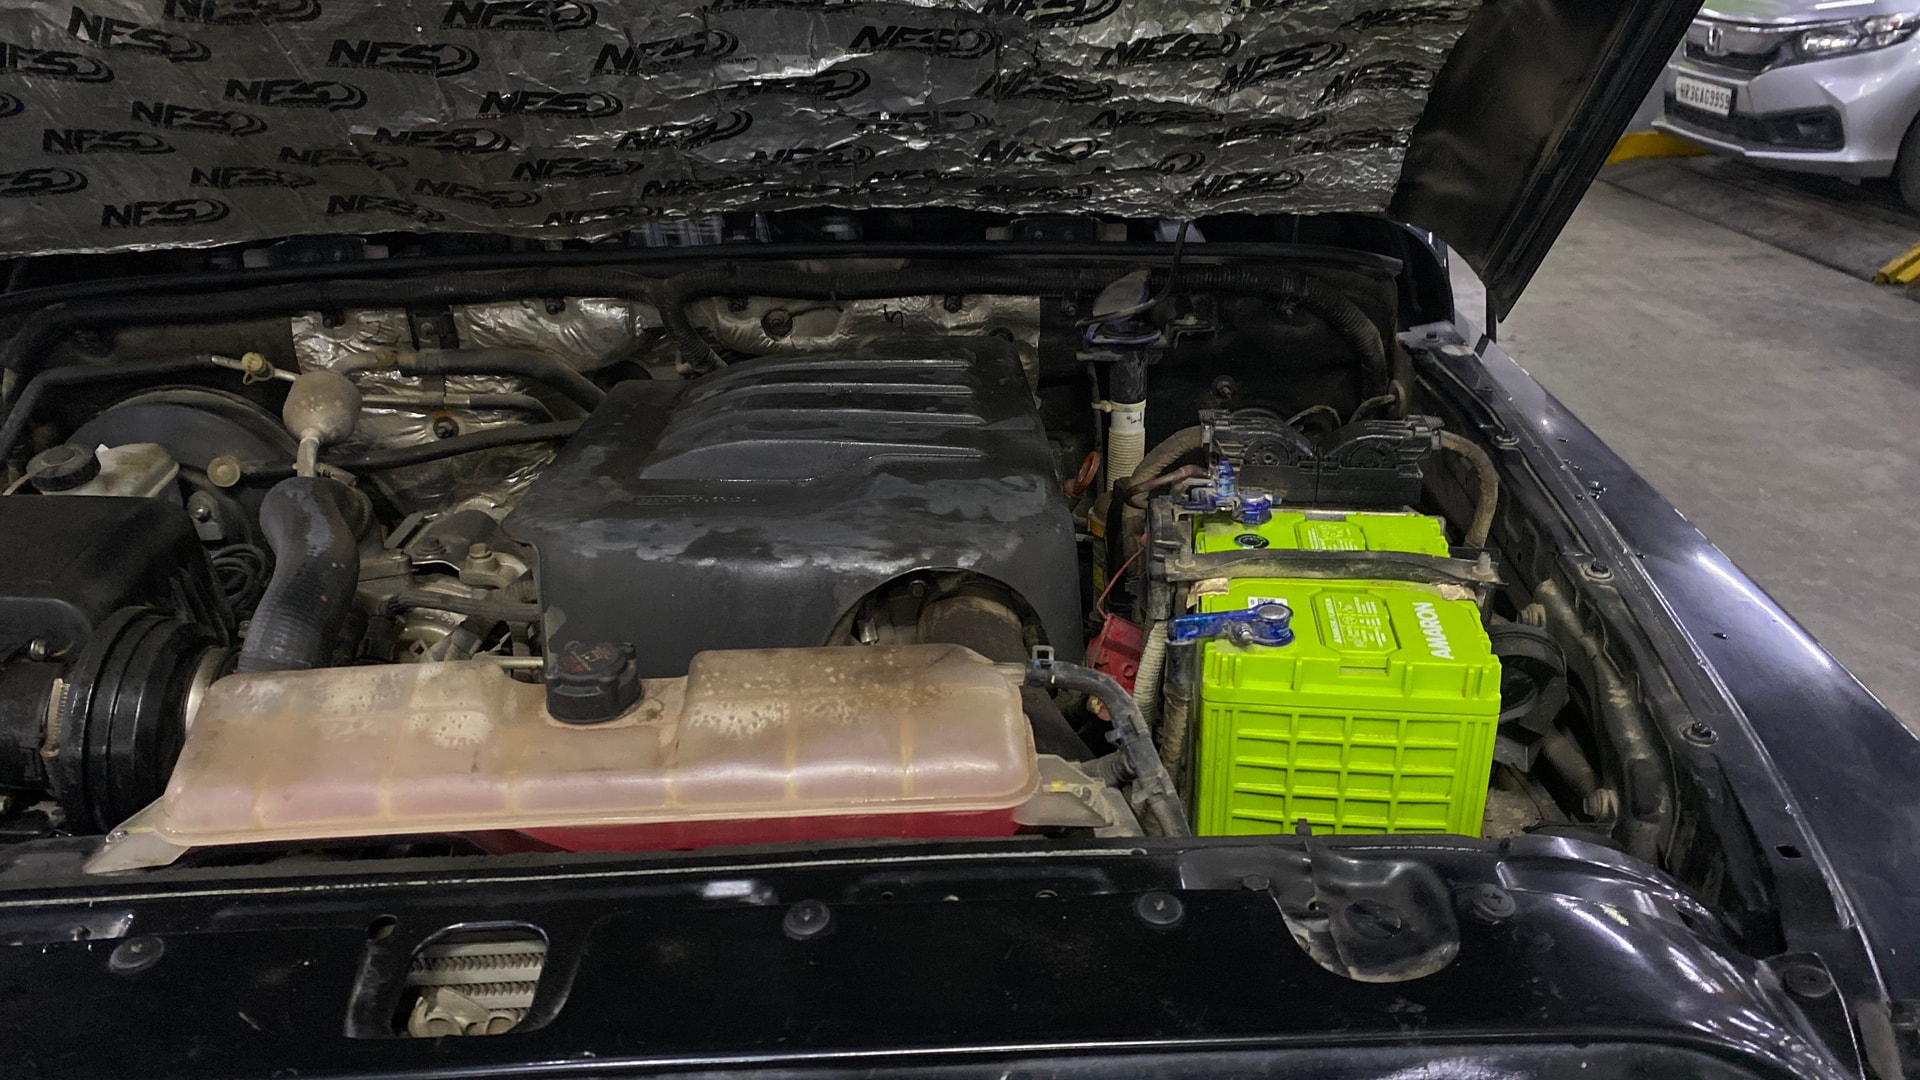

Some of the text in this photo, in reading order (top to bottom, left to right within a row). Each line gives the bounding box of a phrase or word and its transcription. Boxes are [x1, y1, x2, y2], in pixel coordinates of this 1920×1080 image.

[67, 6, 174, 55] NFS
[0, 42, 80, 78] FS
[326, 39, 444, 75] NFS
[224, 79, 332, 107] NFS
[132, 101, 234, 134] NFS
[43, 128, 152, 153] NFS
[189, 166, 288, 189] NFS
[101, 200, 200, 229] NFS
[1411, 602, 1455, 660] AMARON
